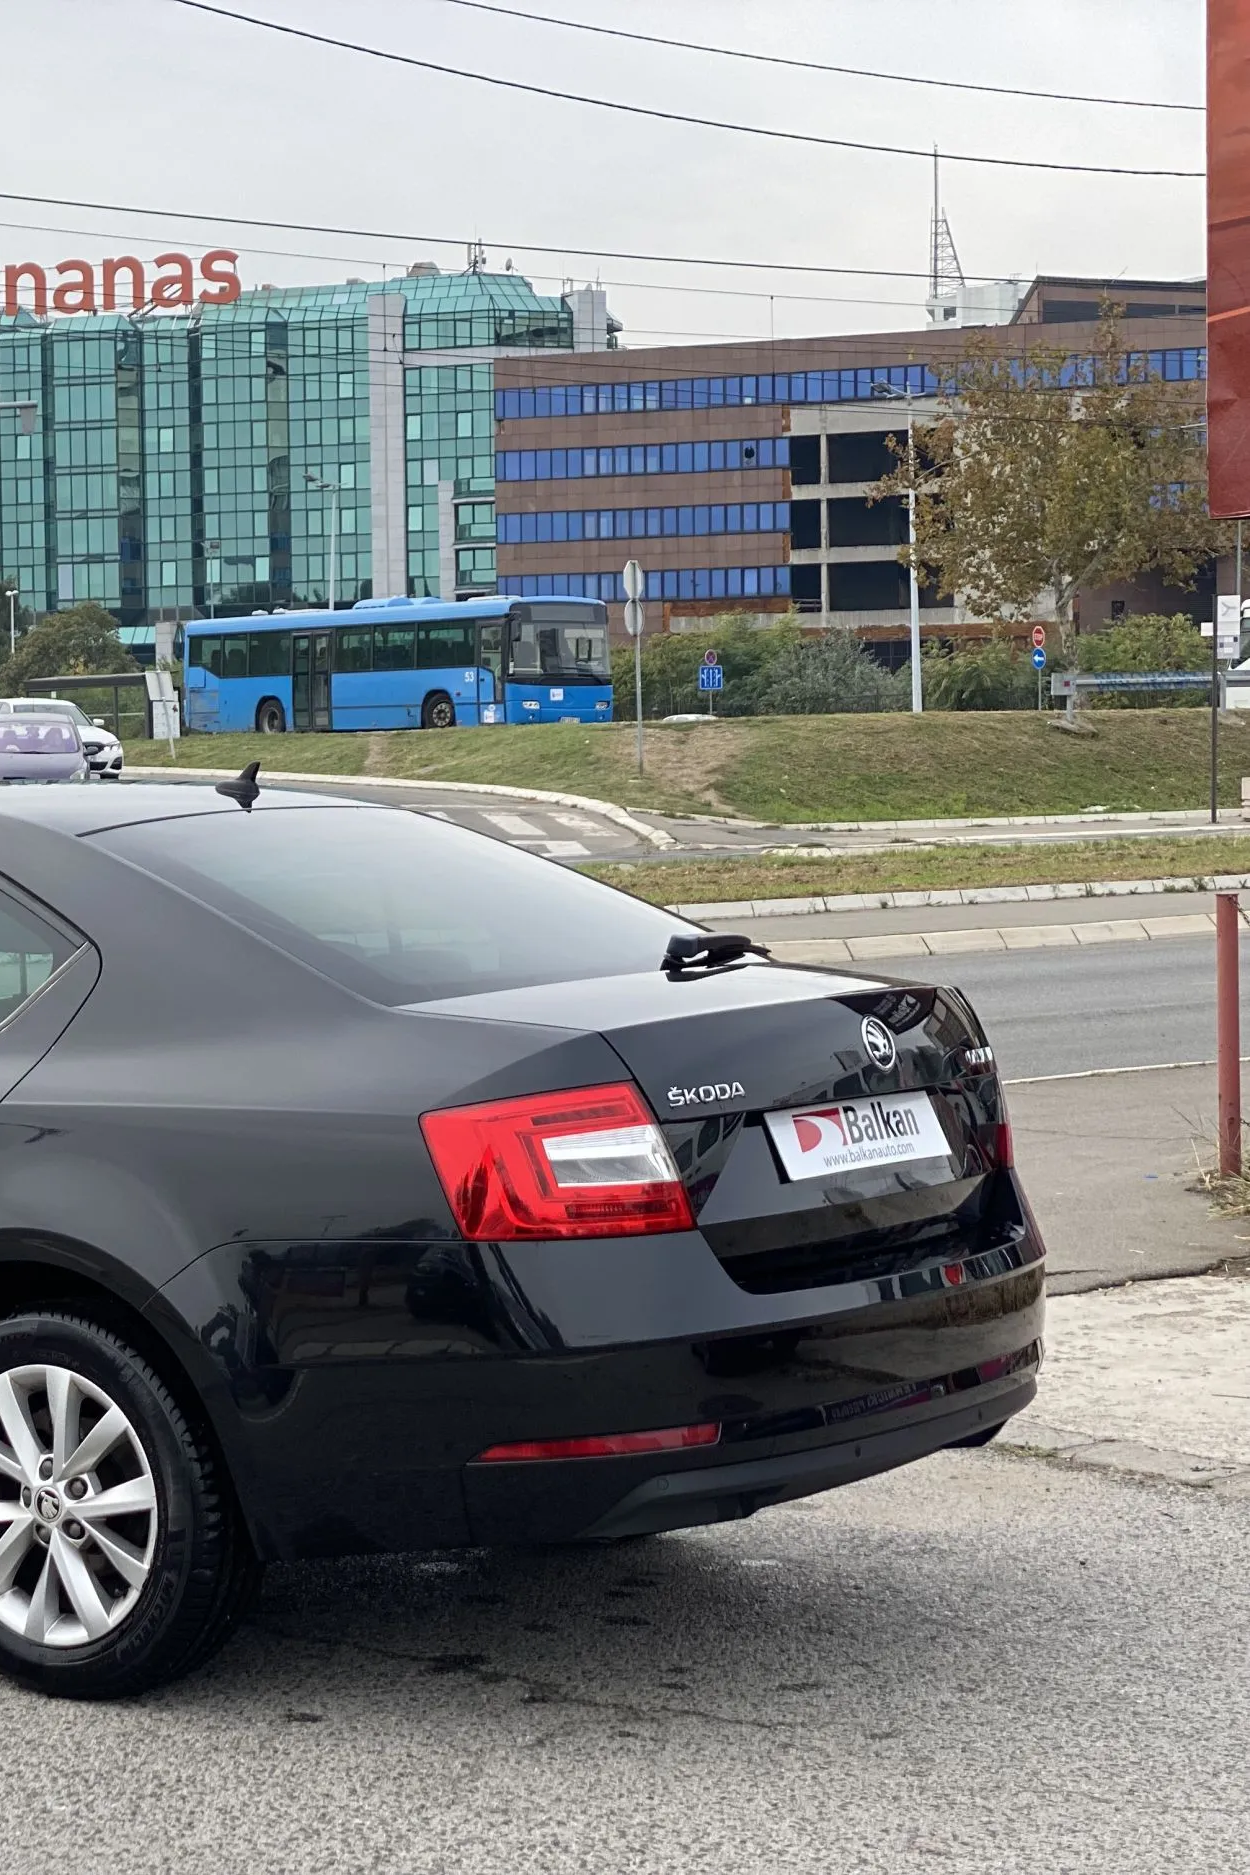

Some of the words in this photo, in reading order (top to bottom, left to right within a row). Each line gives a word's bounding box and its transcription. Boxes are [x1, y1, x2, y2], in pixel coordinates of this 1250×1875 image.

[464, 671, 475, 683] 53
[667, 1081, 746, 1108] ŠKODA
[842, 1101, 920, 1145] Balkan
[823, 1140, 915, 1168] www.balkanauto.com
